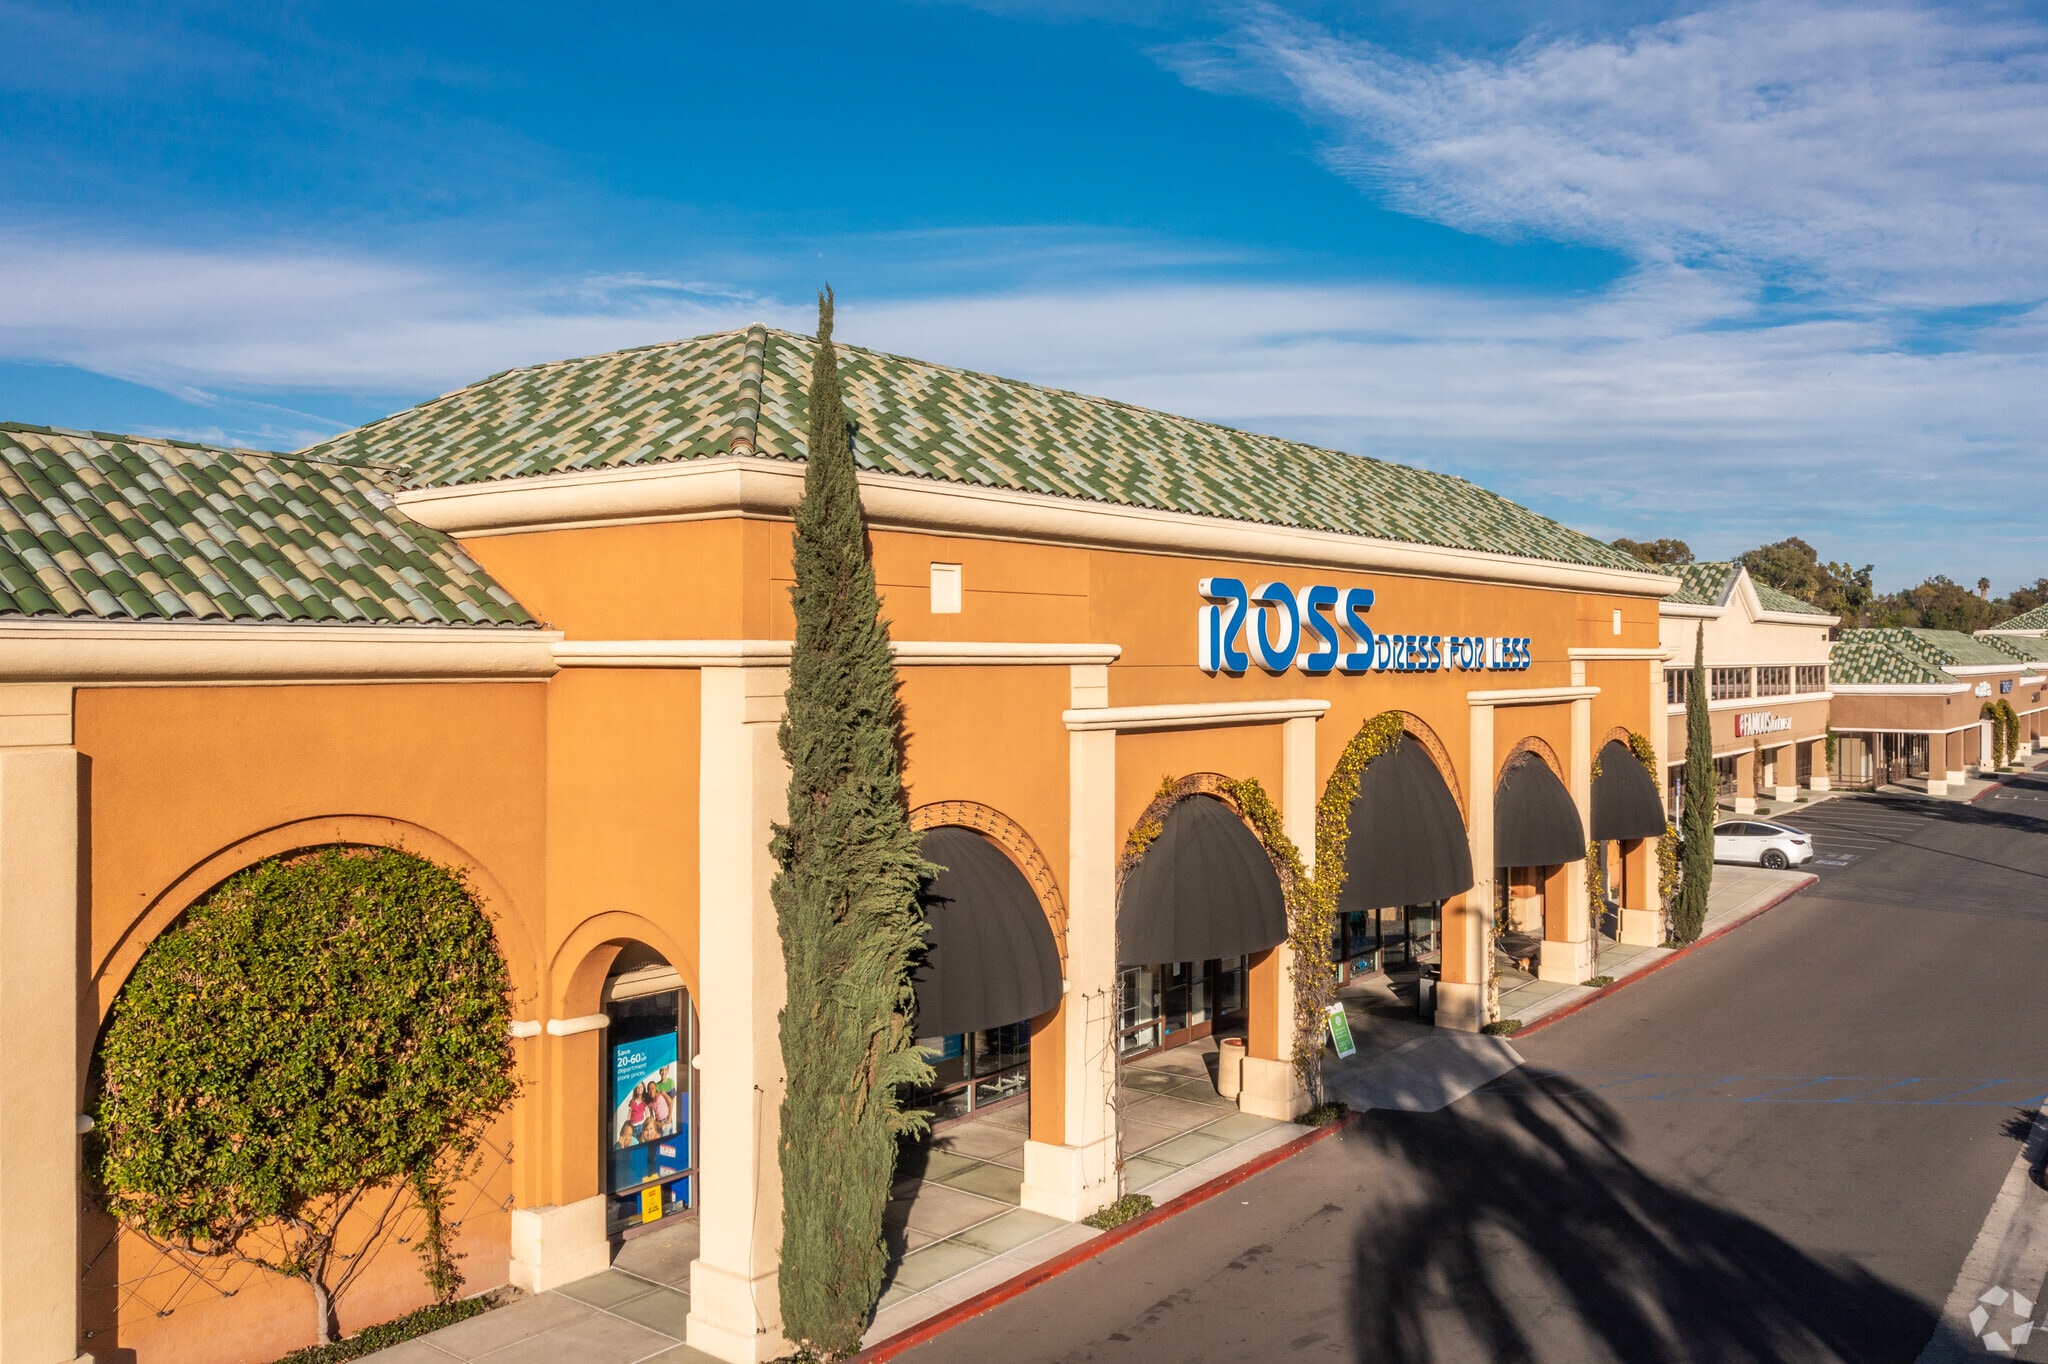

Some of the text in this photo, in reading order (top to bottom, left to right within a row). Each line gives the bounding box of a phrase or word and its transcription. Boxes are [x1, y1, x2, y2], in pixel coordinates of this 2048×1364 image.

[1198, 577, 1531, 672] ROSS DRESS FOR LESS
[1744, 711, 1771, 736] FAMOUS
[617, 1049, 631, 1057] Save
[617, 1062, 647, 1074] department
[617, 1074, 631, 1082] store
